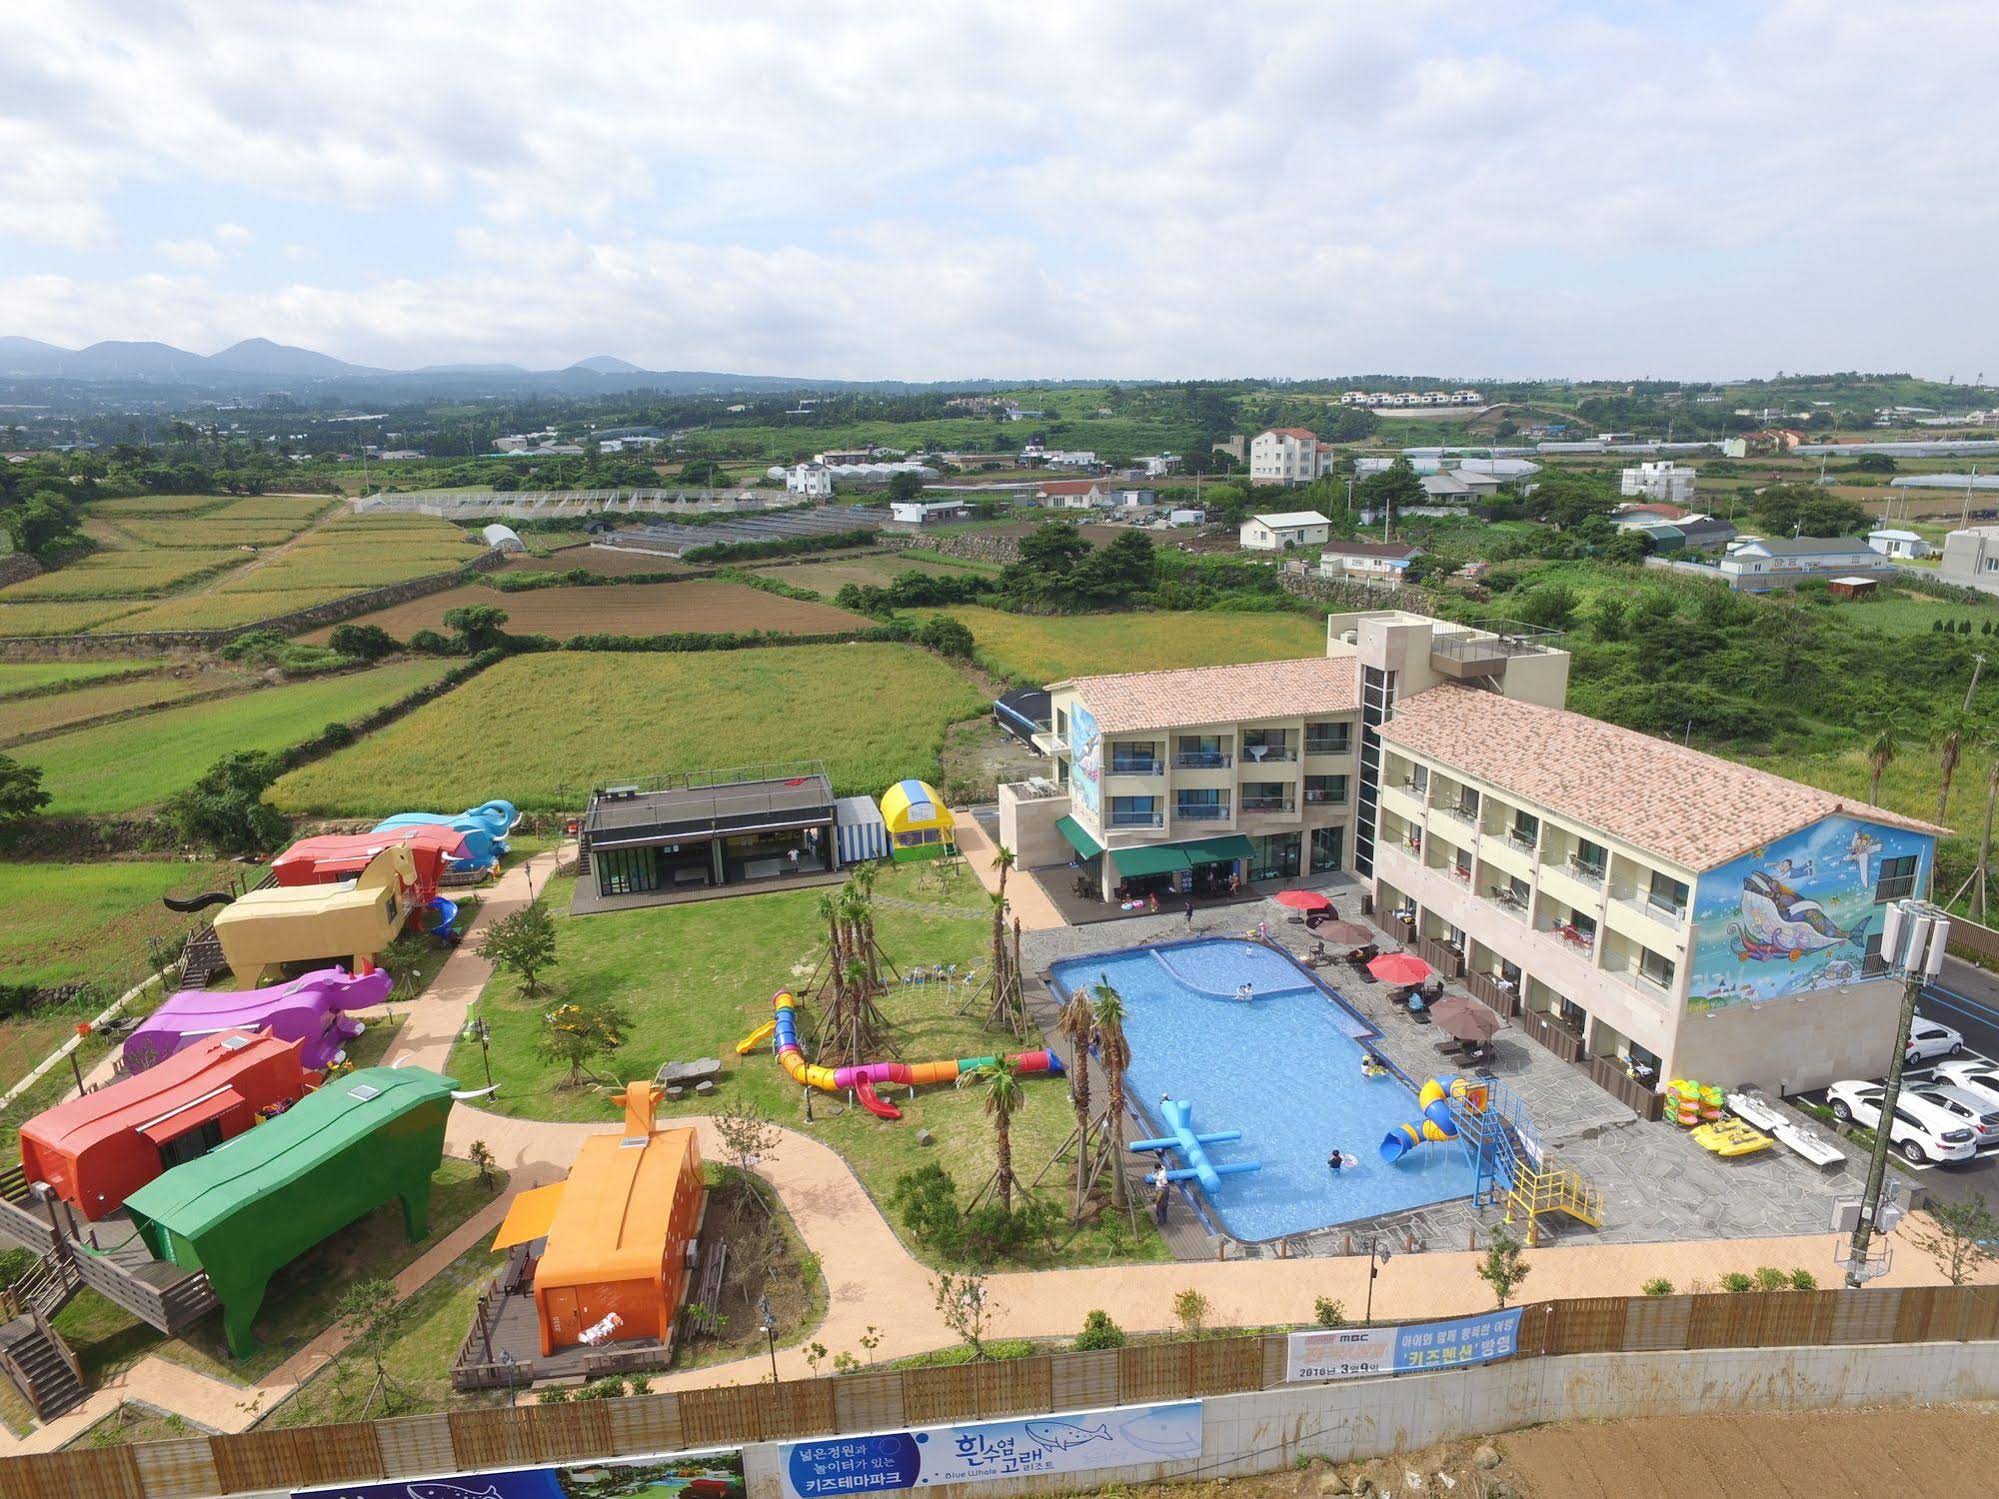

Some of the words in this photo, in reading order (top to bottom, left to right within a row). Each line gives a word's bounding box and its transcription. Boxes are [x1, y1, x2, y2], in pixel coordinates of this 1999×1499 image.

[1340, 1334, 1369, 1342] MBC
[1402, 1333, 1433, 1347] 아이와
[814, 1459, 867, 1475] 놀이터가
[870, 1457, 895, 1468] 있는
[967, 1468, 997, 1477] Whale
[805, 1472, 902, 1492] 키즈테마파크
